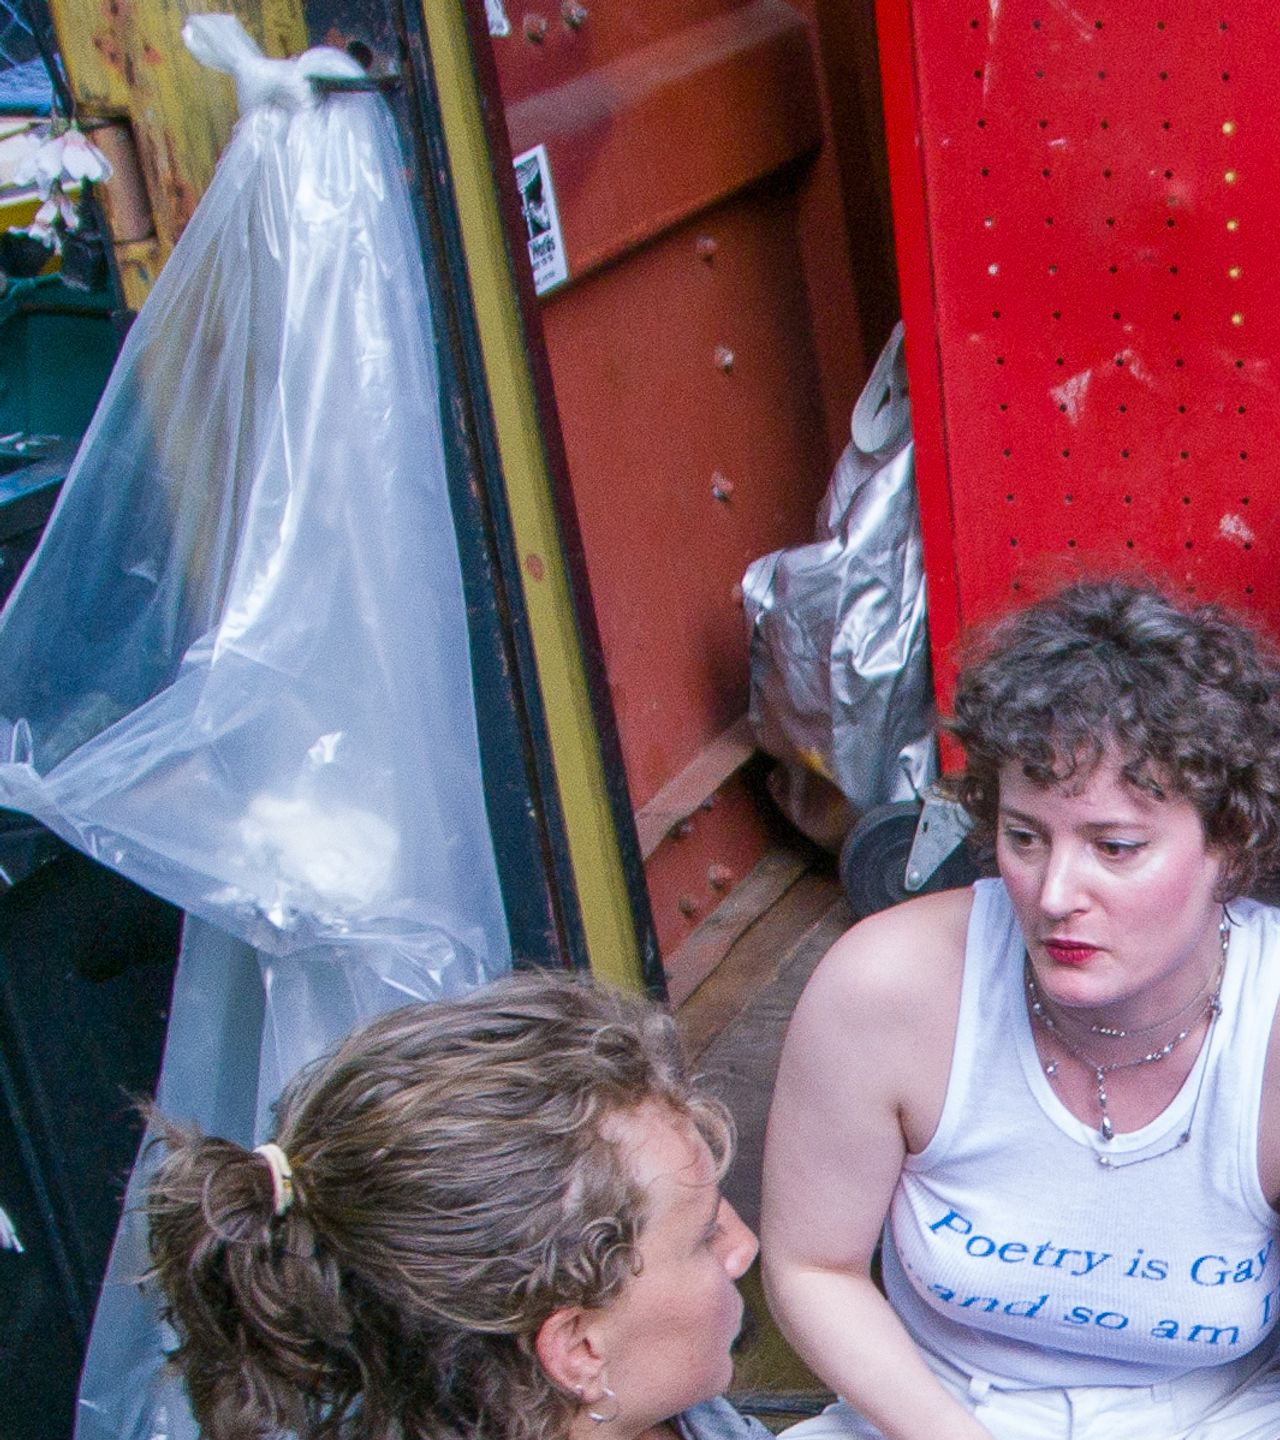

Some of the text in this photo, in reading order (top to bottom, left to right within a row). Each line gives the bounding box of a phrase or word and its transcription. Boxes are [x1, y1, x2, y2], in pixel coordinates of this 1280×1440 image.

[929, 1209, 1273, 1286] Poetry is Gay
[1063, 1305, 1129, 1330] so
[1151, 1319, 1240, 1345] am
